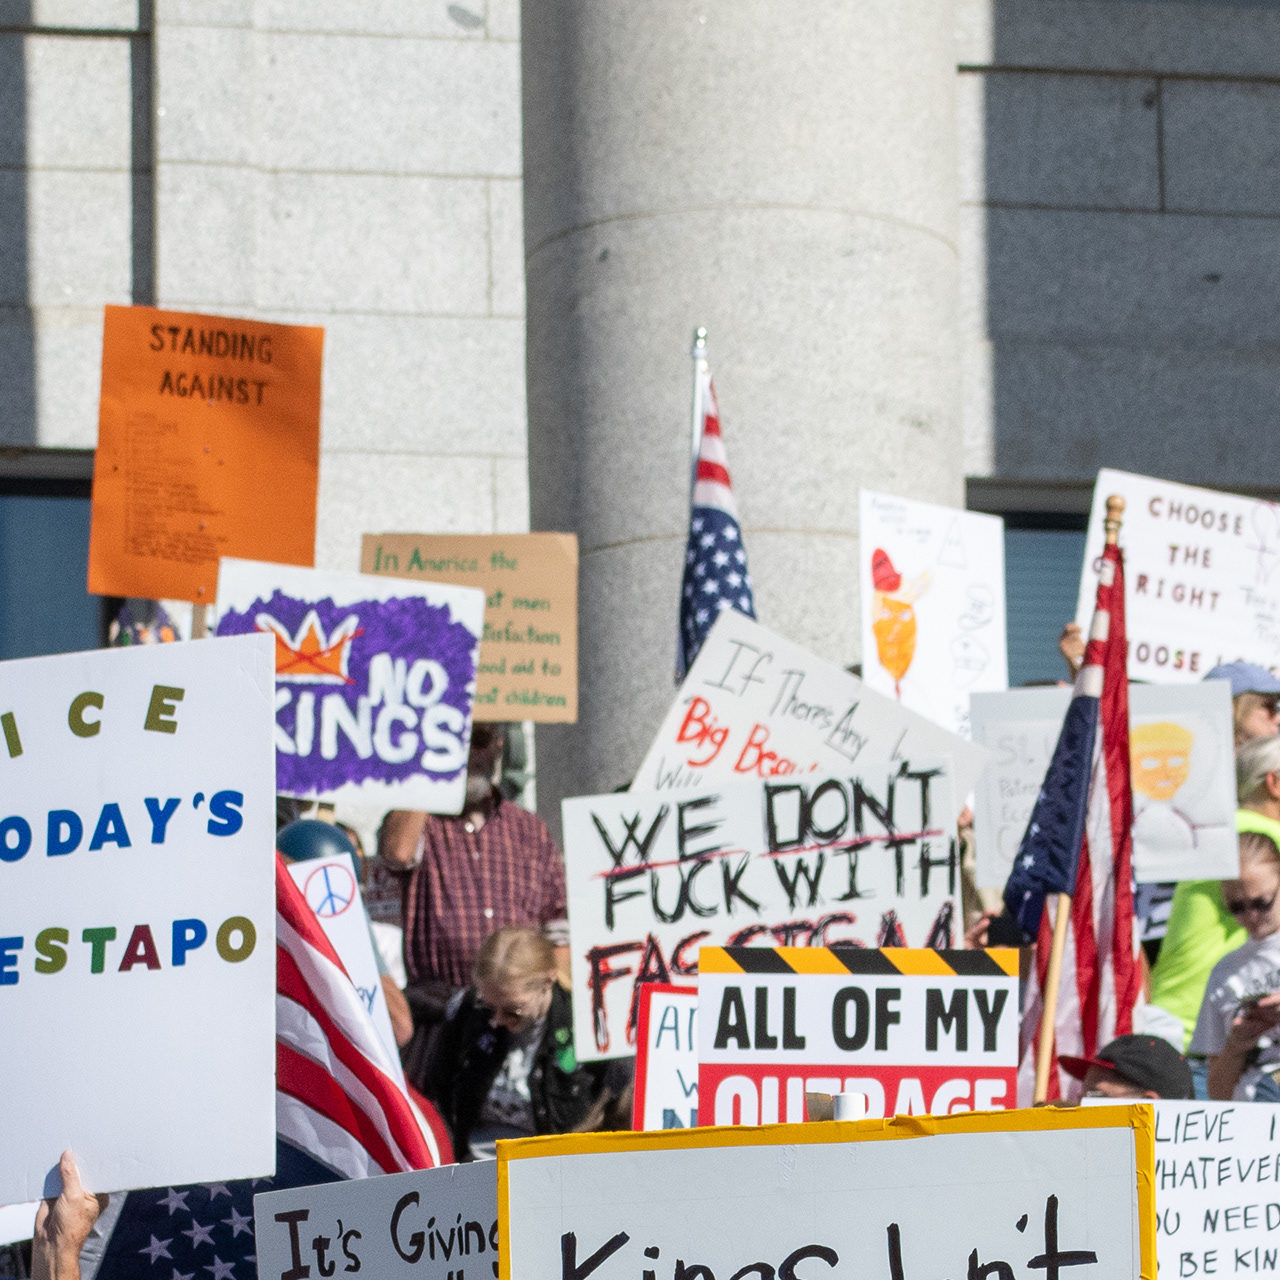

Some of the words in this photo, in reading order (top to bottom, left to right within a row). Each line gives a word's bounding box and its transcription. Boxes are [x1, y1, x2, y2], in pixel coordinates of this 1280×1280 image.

[150, 324, 273, 365] STANDING
[160, 371, 270, 406] AGAINST
[1148, 497, 1243, 536] CHOOSE
[1169, 544, 1212, 568] THE
[1135, 573, 1221, 611] RIGHT
[369, 652, 449, 707] NO
[704, 638, 774, 697] If
[0, 684, 186, 759] ICE
[676, 695, 730, 768] Big
[590, 792, 723, 866] WE
[605, 852, 762, 932] FUCK
[772, 834, 957, 910] WITH
[714, 985, 807, 1051] ALL
[830, 985, 902, 1052] OF
[924, 987, 1010, 1053] MY
[1179, 1249, 1219, 1278] BE
